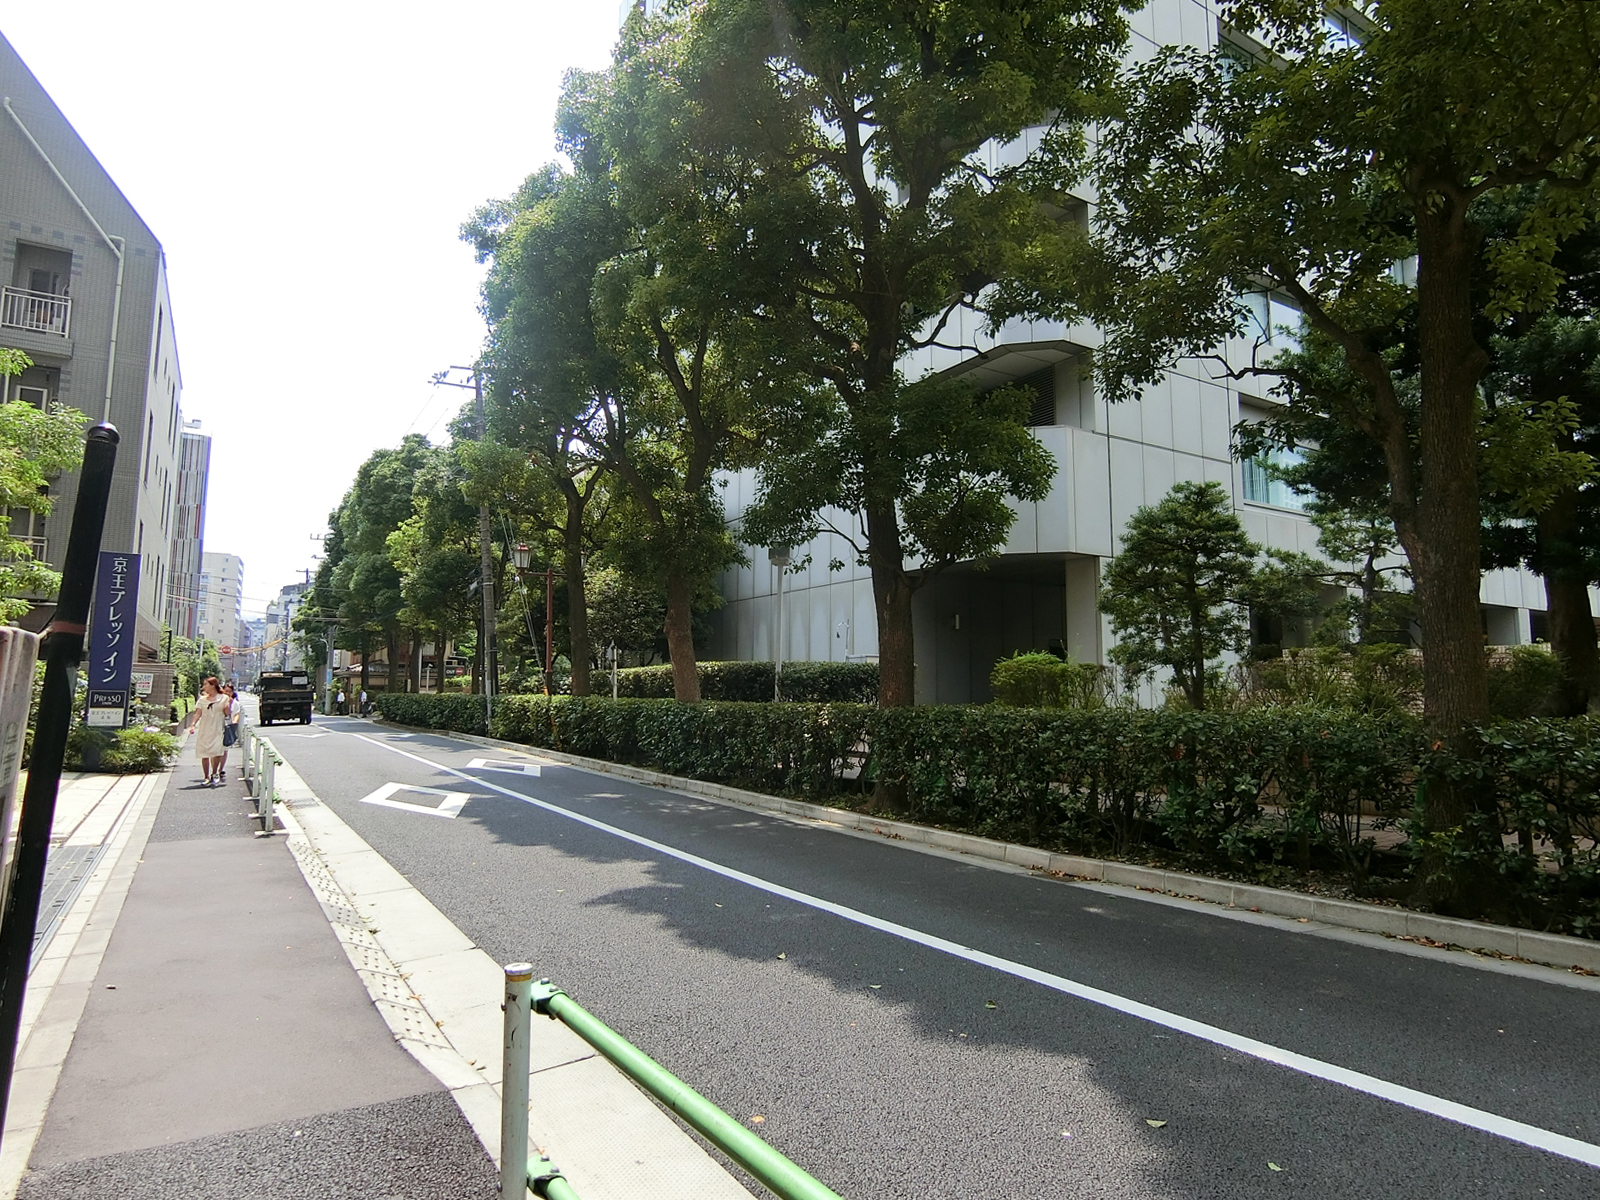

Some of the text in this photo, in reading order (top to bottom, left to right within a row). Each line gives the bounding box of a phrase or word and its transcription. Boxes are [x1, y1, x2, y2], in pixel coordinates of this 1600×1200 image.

[102, 556, 129, 683] 京王プレッソイン
